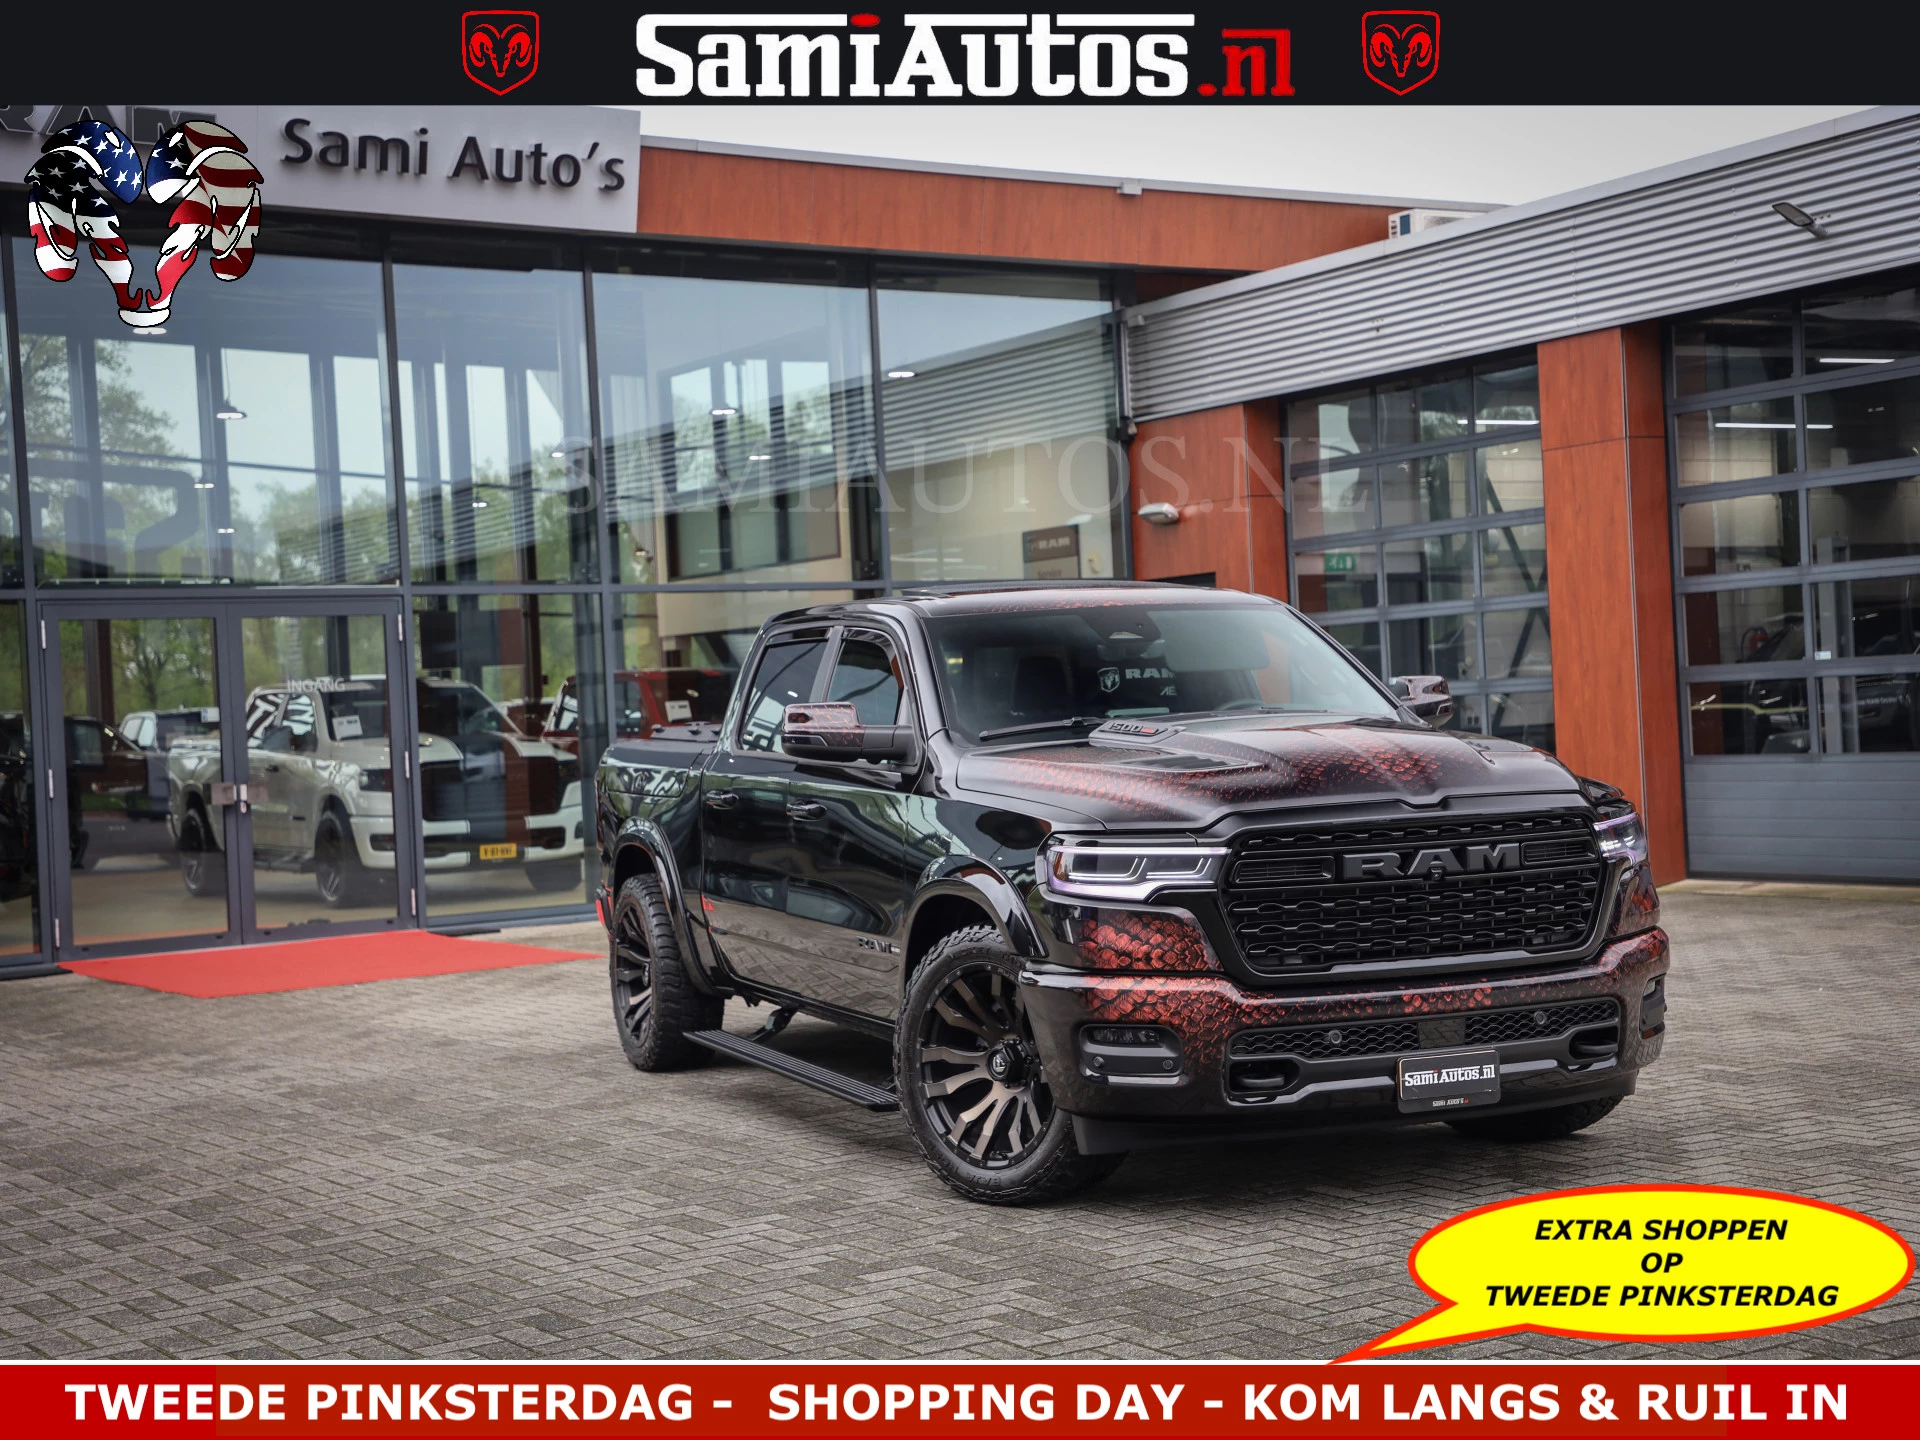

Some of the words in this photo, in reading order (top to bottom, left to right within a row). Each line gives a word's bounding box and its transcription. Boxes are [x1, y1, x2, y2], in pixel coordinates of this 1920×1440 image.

[281, 118, 429, 178] Sami
[447, 136, 626, 193] Auto's
[287, 677, 346, 693] INGANG
[1343, 843, 1521, 880] RAM
[856, 935, 893, 954] RAM
